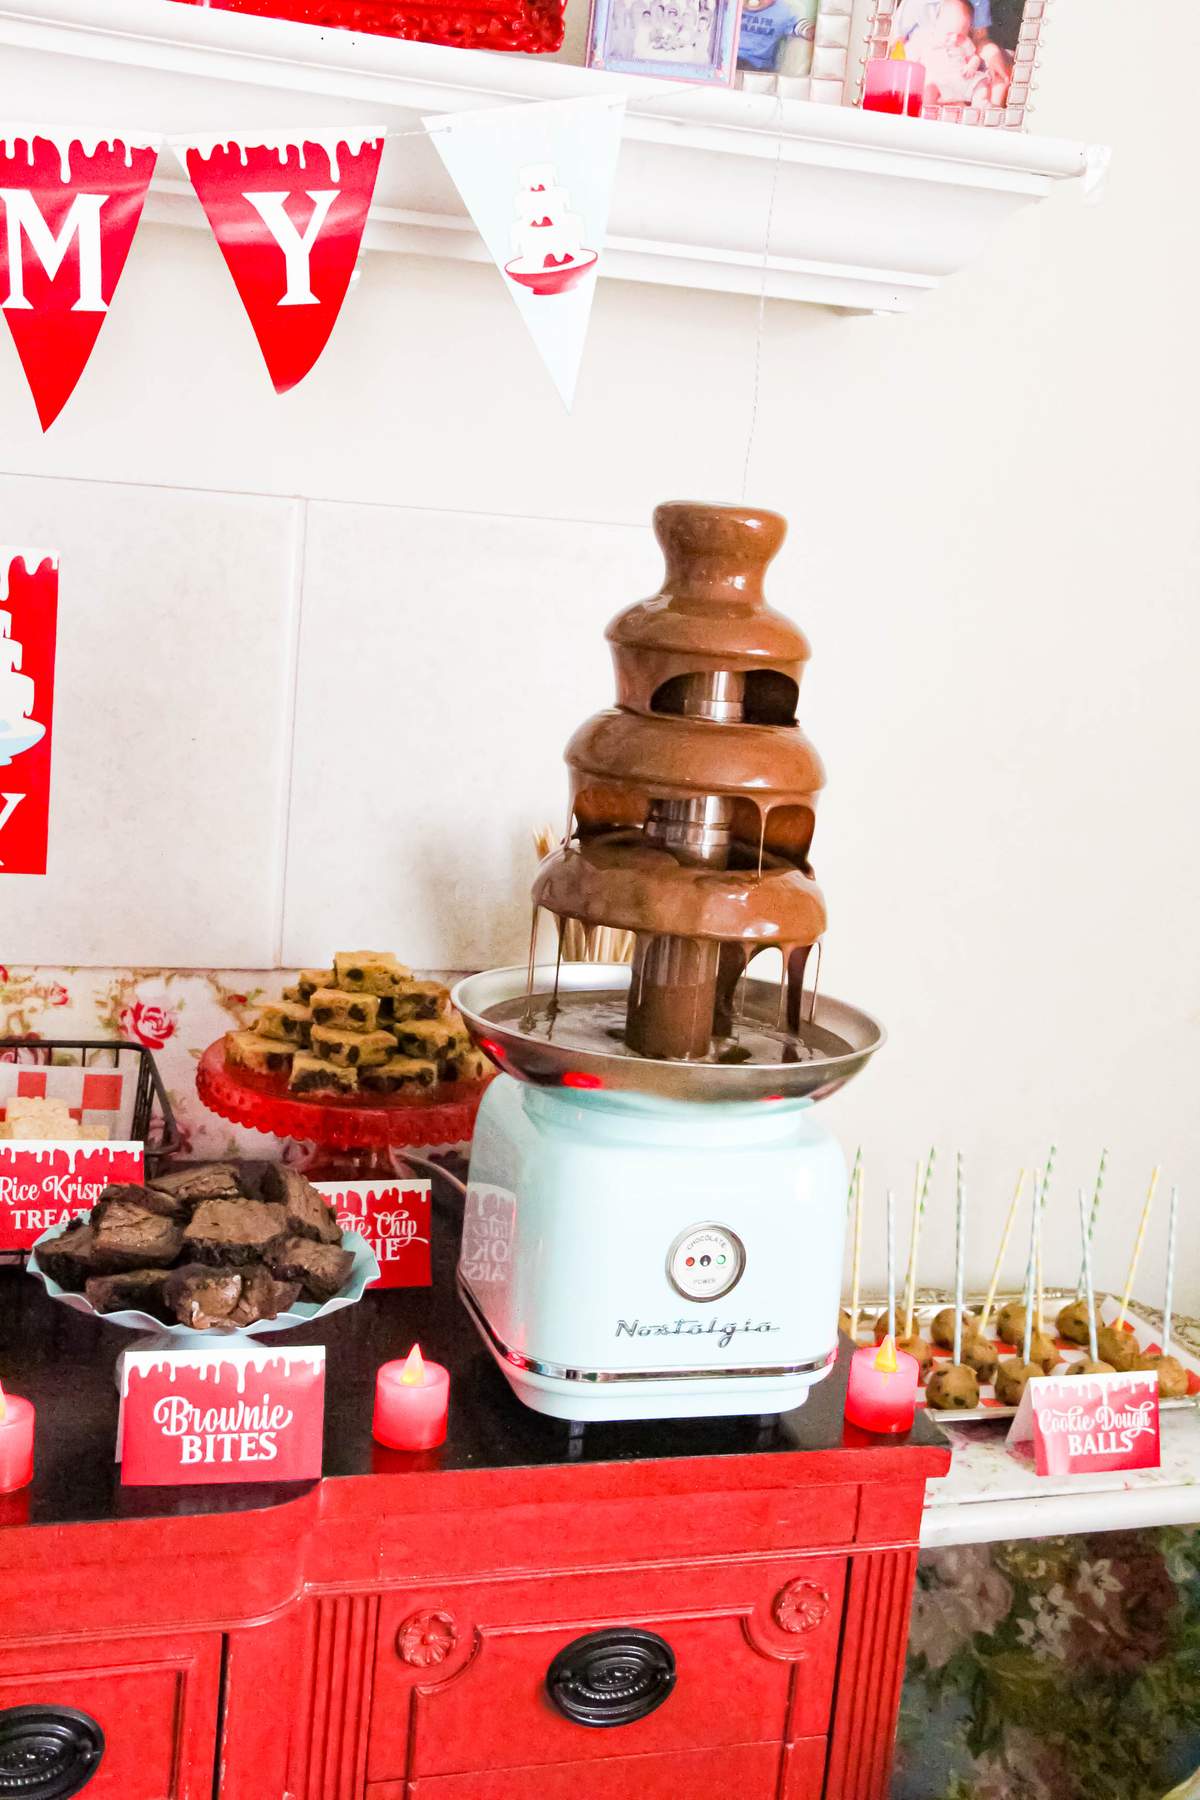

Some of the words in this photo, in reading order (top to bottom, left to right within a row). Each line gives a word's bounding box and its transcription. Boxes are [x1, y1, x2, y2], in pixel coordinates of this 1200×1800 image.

[0, 1176, 40, 1206] Rice
[373, 1209, 429, 1248] Chip
[686, 1234, 727, 1250] CHOCOLATE
[615, 1317, 780, 1349] Nostalgia
[153, 1393, 293, 1436] Brownie
[1039, 1406, 1095, 1434] Cookie
[1095, 1401, 1156, 1438] Dough
[179, 1431, 278, 1464] BITES
[1068, 1430, 1134, 1456] BALLS
